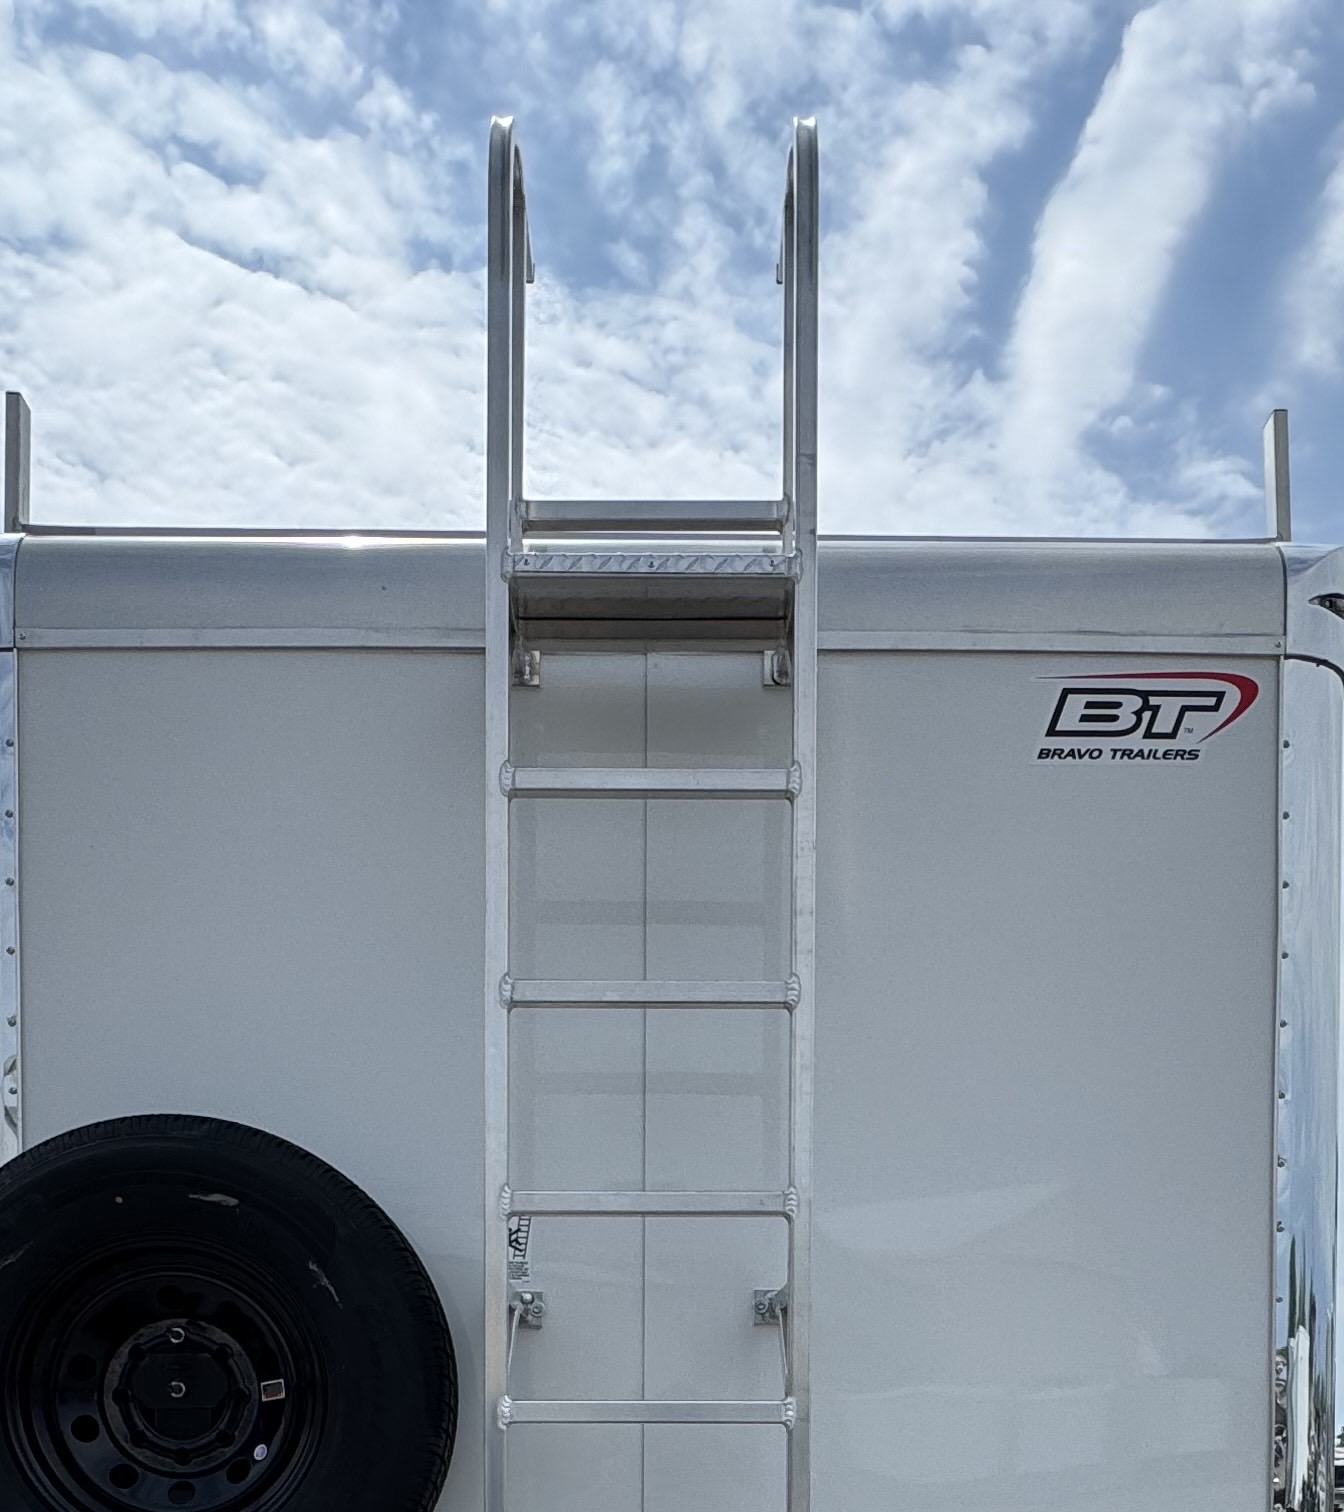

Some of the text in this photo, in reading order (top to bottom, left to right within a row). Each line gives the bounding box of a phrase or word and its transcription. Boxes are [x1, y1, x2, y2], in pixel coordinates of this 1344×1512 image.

[1045, 687, 1226, 740] BT
[1037, 747, 1201, 761] BRAVO TRAILERS
